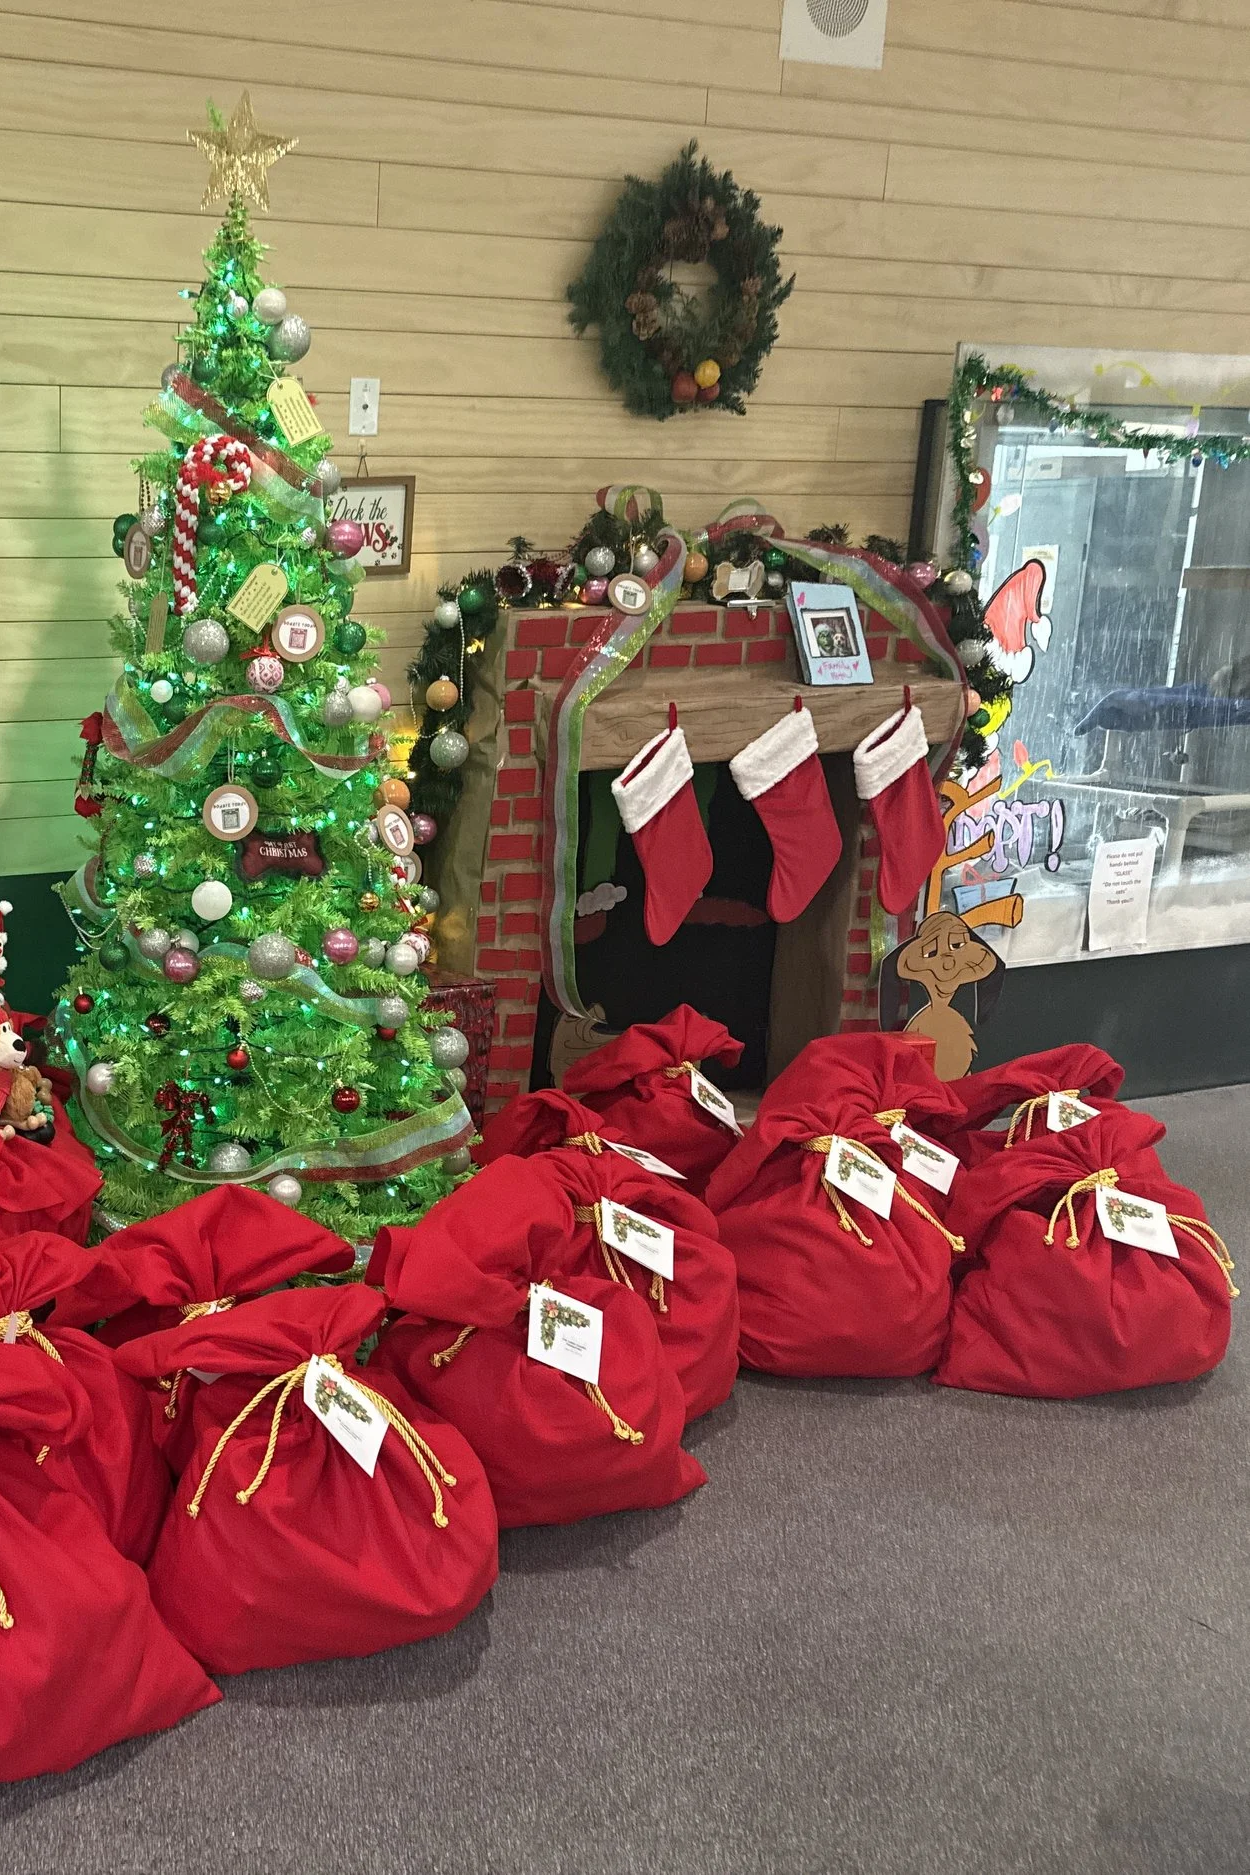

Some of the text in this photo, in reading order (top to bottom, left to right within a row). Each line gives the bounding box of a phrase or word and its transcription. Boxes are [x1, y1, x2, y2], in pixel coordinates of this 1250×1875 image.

[331, 496, 387, 521] Deck the
[358, 522, 388, 552] WS
[259, 846, 308, 858] CHRISTMAS
